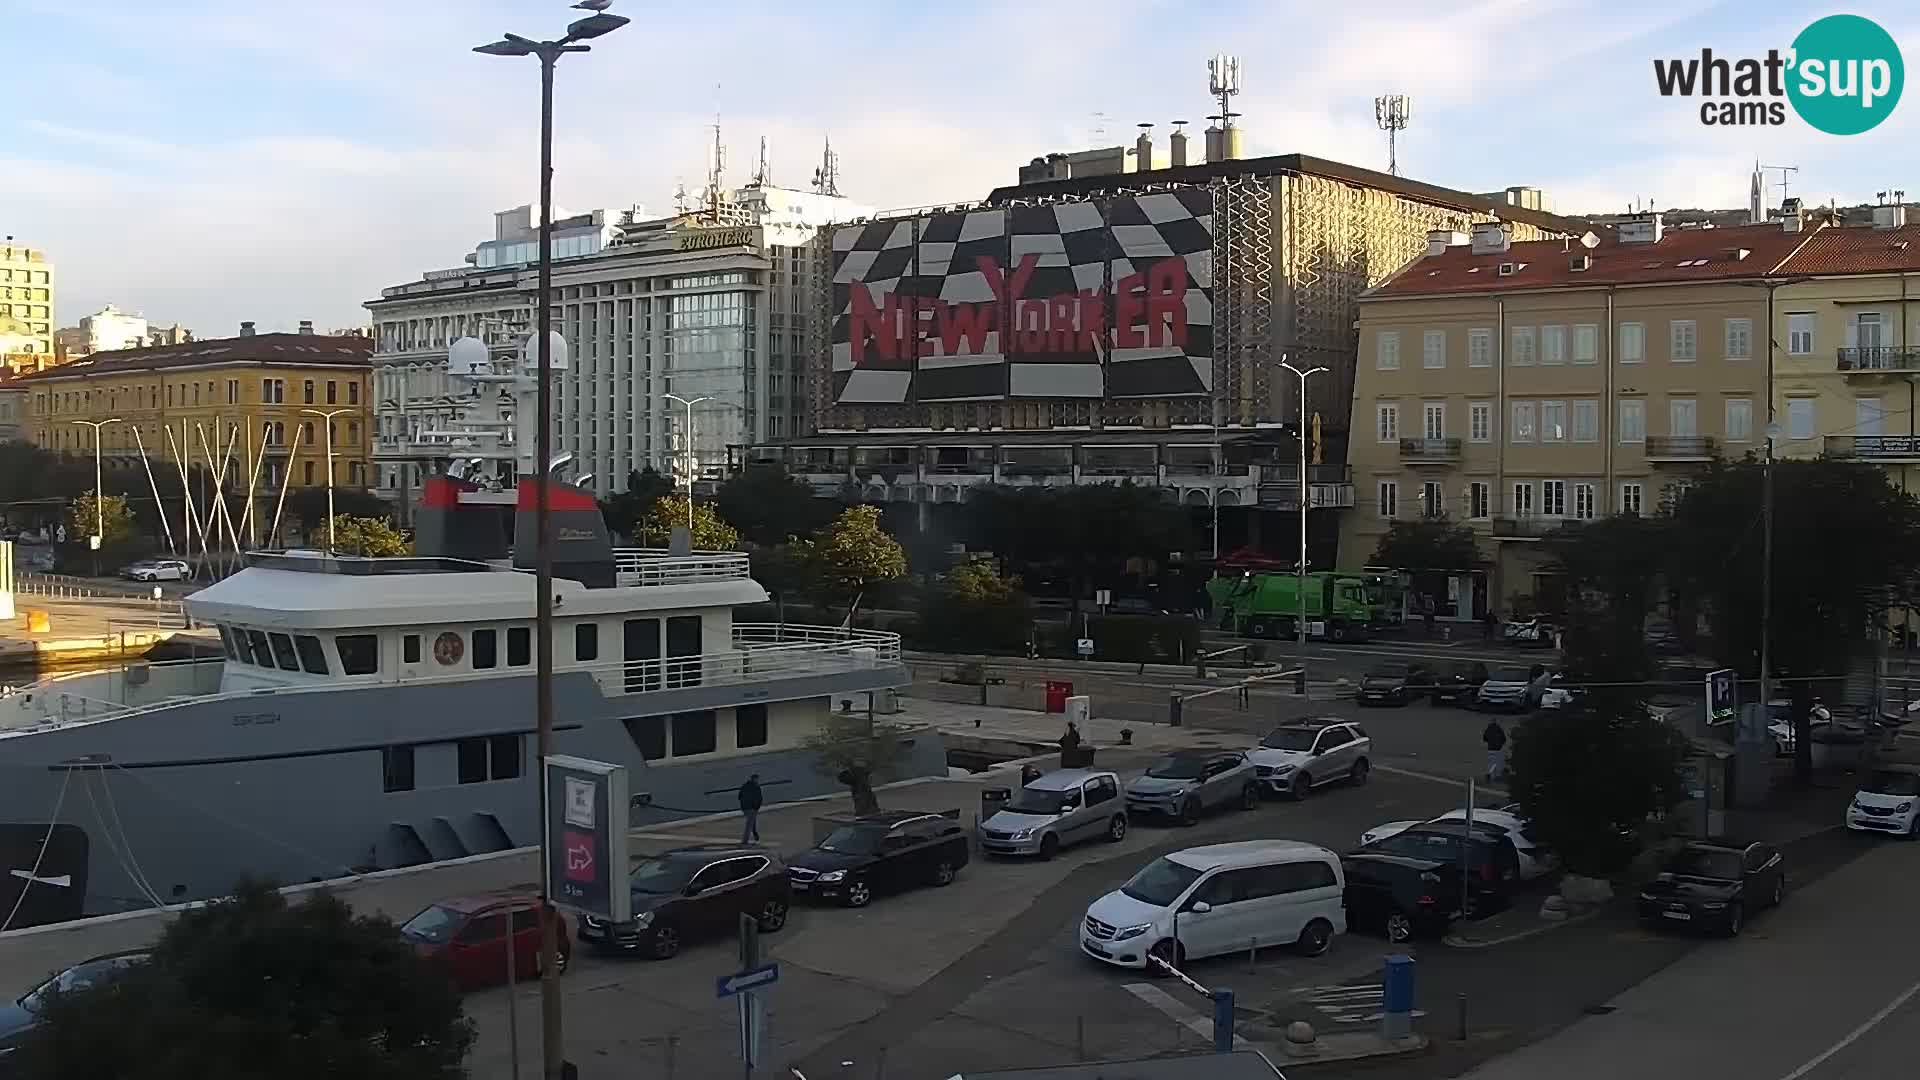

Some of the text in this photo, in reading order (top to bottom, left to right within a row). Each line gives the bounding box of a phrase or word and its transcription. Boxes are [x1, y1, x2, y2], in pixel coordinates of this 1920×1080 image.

[680, 229, 753, 249] EUROHERC
[850, 253, 1188, 362] NEW YORKER
